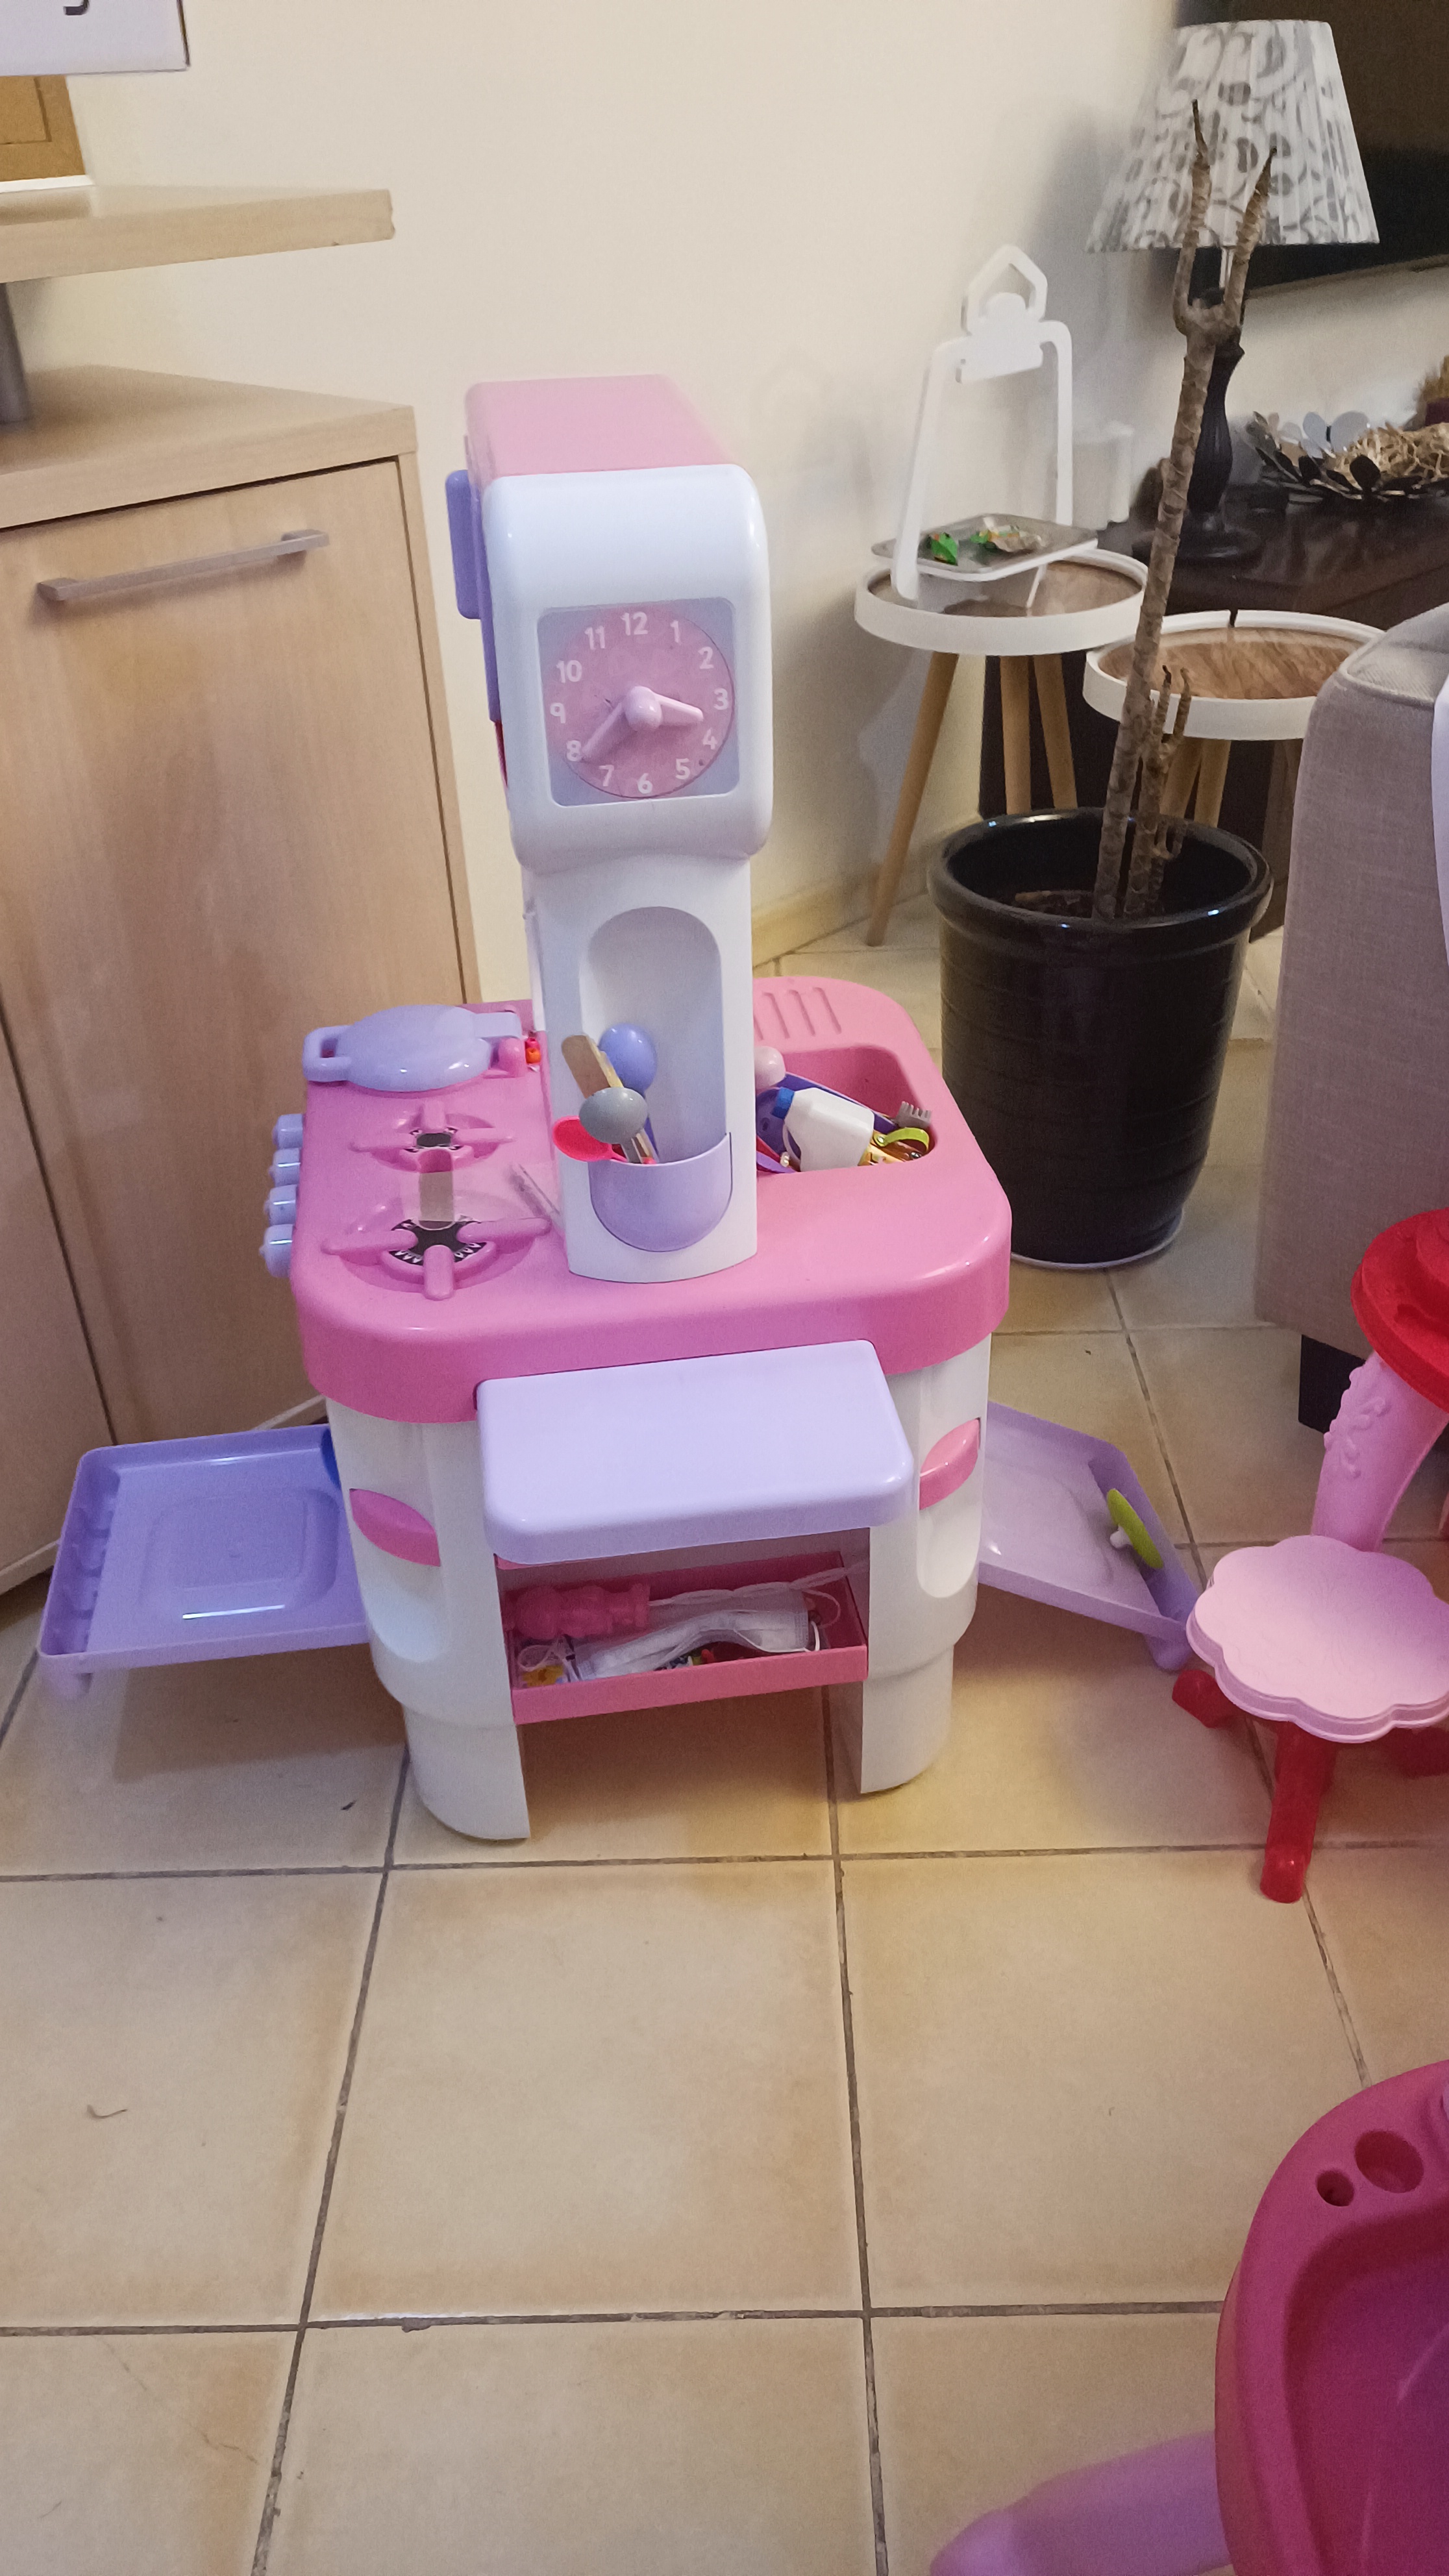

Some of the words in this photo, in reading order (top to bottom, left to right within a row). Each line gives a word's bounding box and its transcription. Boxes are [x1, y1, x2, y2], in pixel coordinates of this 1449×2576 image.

[620, 612, 648, 636] 12
[670, 620, 680, 643] 1
[584, 625, 606, 649] 11
[698, 647, 713, 669] 2
[556, 660, 582, 683] 10
[714, 688, 728, 710] 3
[550, 702, 566, 724] 9
[702, 728, 717, 750] 4
[566, 740, 582, 762] 8
[599, 765, 615, 787] 7
[676, 758, 690, 780] 5
[637, 773, 653, 794] 6
